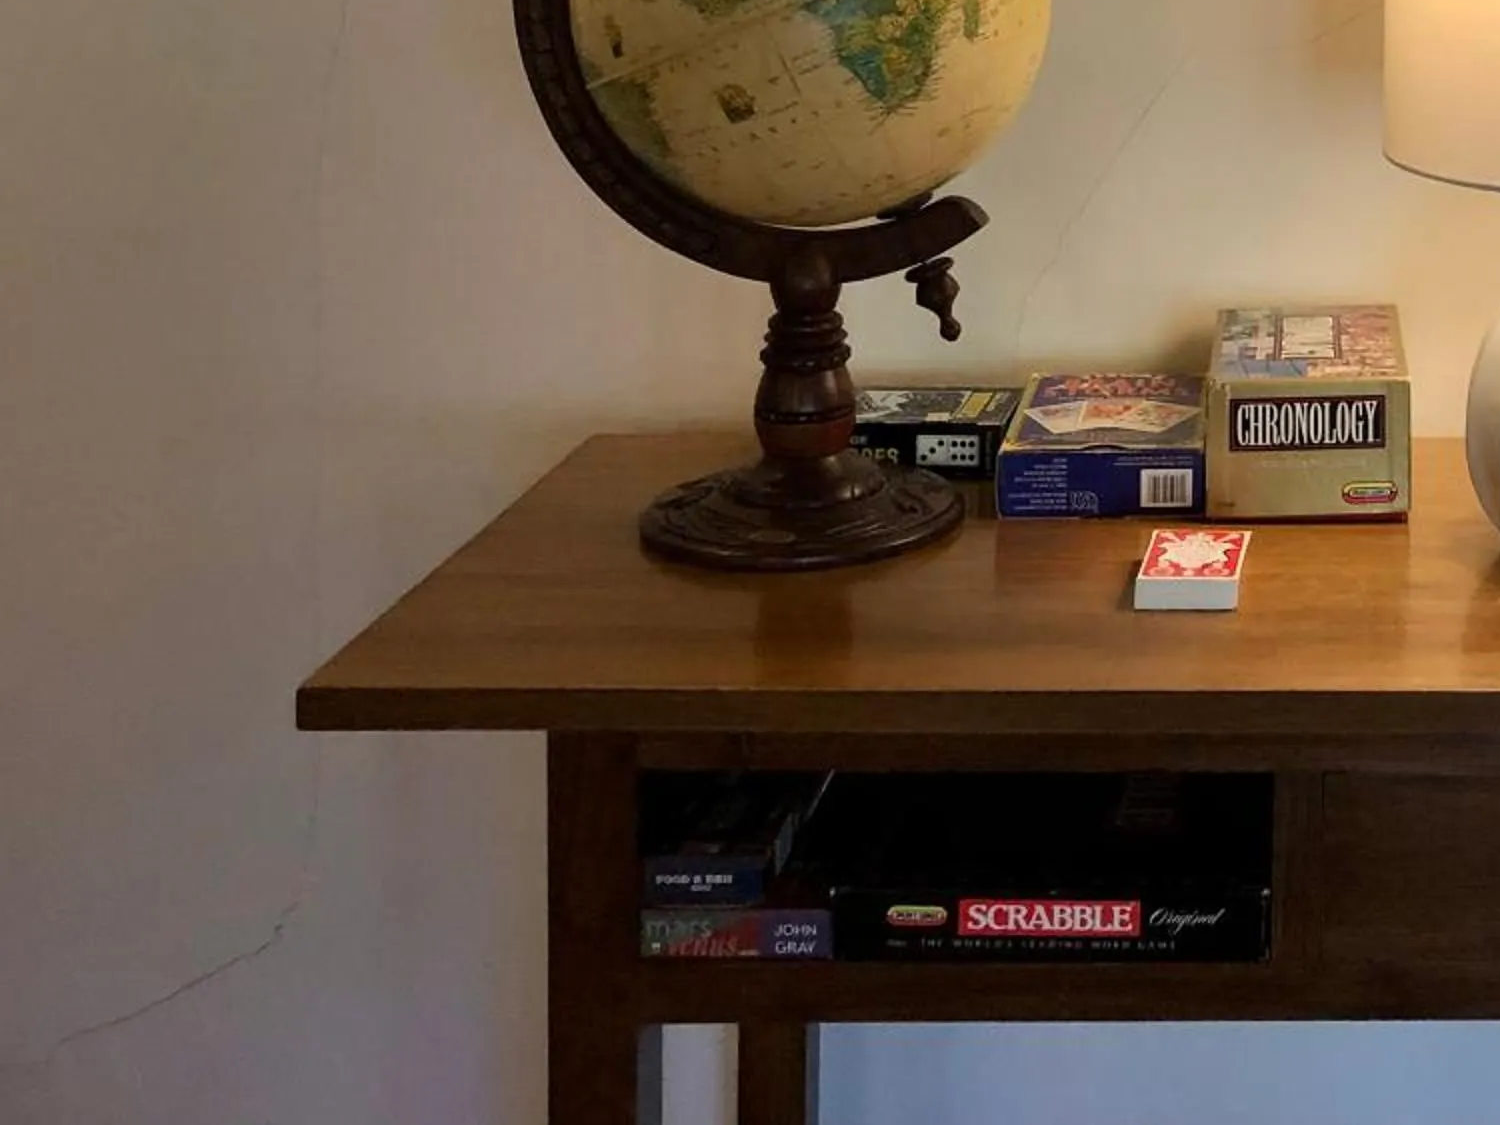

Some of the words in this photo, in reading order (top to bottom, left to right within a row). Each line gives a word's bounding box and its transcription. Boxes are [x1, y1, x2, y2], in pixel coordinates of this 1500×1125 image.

[1236, 400, 1377, 446] CHRONOLOGY
[773, 923, 817, 937] JOHN
[967, 903, 1133, 932] SCRABBLE
[1148, 907, 1227, 936] Original
[774, 940, 818, 955] GRAY
